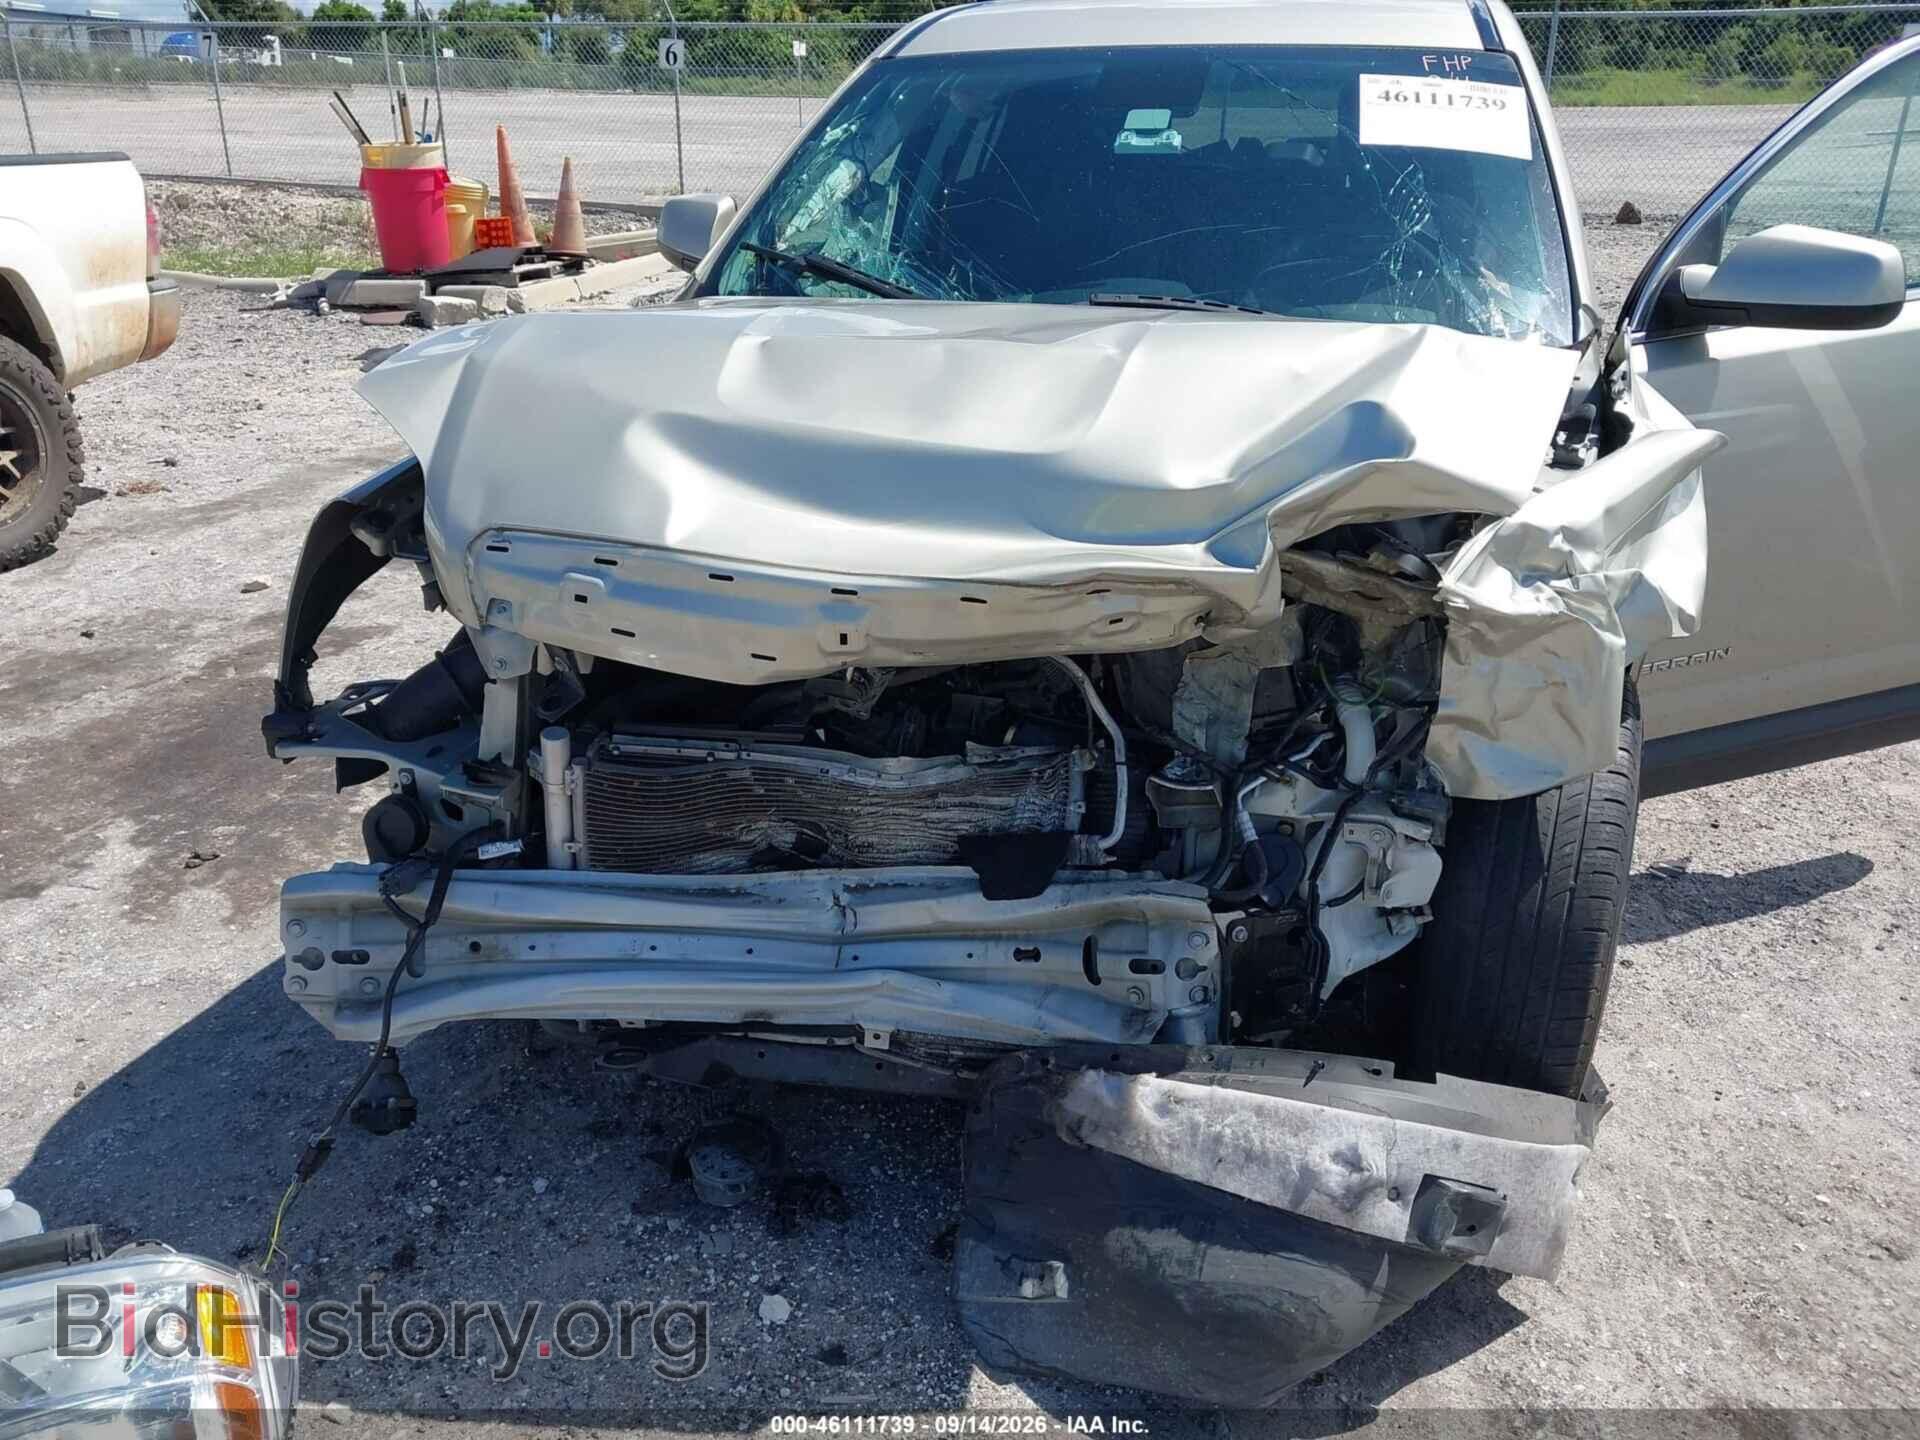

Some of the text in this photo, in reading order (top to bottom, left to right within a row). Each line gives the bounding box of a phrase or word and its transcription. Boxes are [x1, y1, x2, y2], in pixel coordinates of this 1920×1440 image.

[202, 34, 212, 57] 7
[665, 42, 678, 66] 6
[1377, 89, 1507, 111] 46111739
[1640, 646, 1733, 674] ERRAIN
